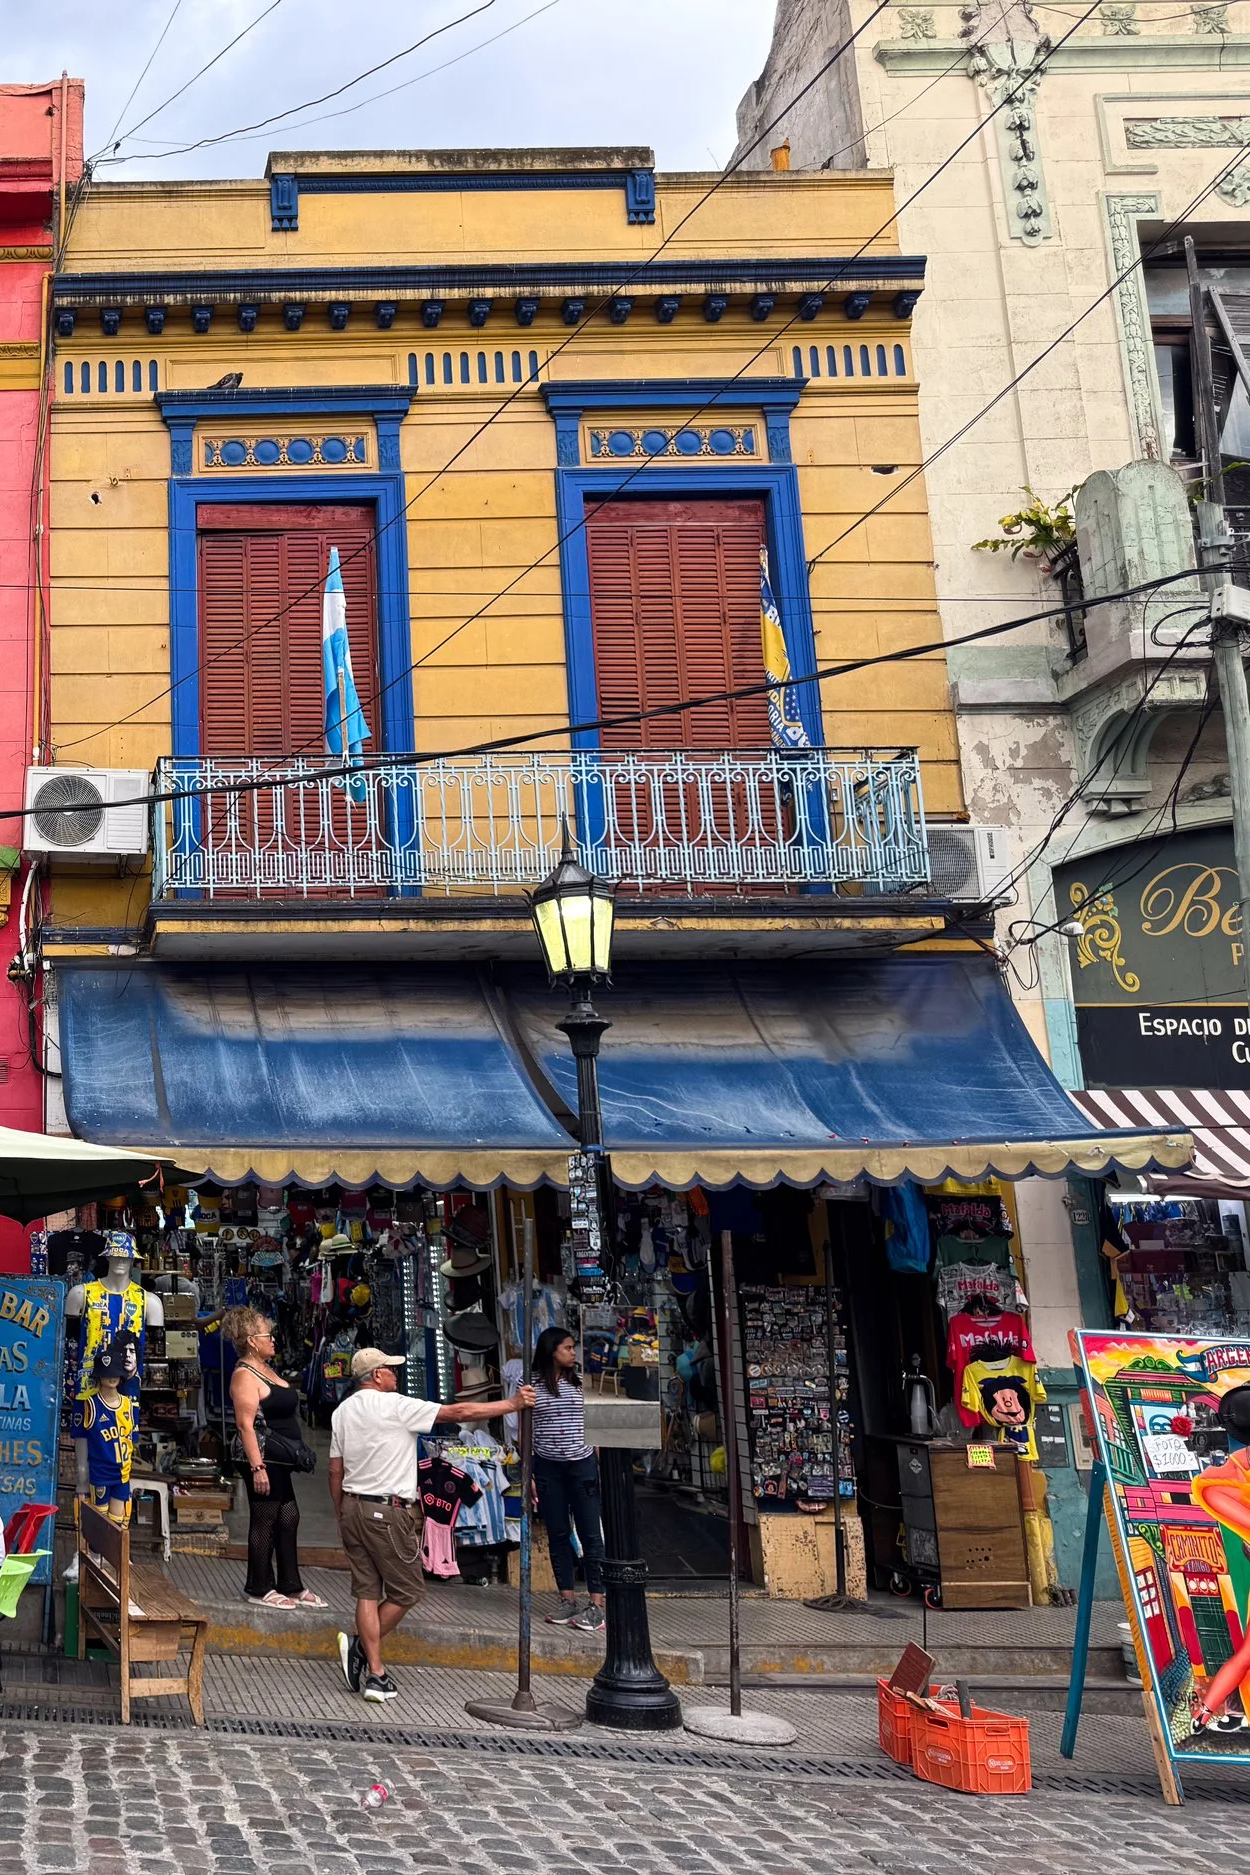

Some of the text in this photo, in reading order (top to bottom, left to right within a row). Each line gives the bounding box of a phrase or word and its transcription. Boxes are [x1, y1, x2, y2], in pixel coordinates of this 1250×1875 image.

[1138, 1012, 1222, 1036] ESPACIO
[941, 1203, 991, 1218] Mafalda
[957, 1279, 1000, 1293] Mafalda
